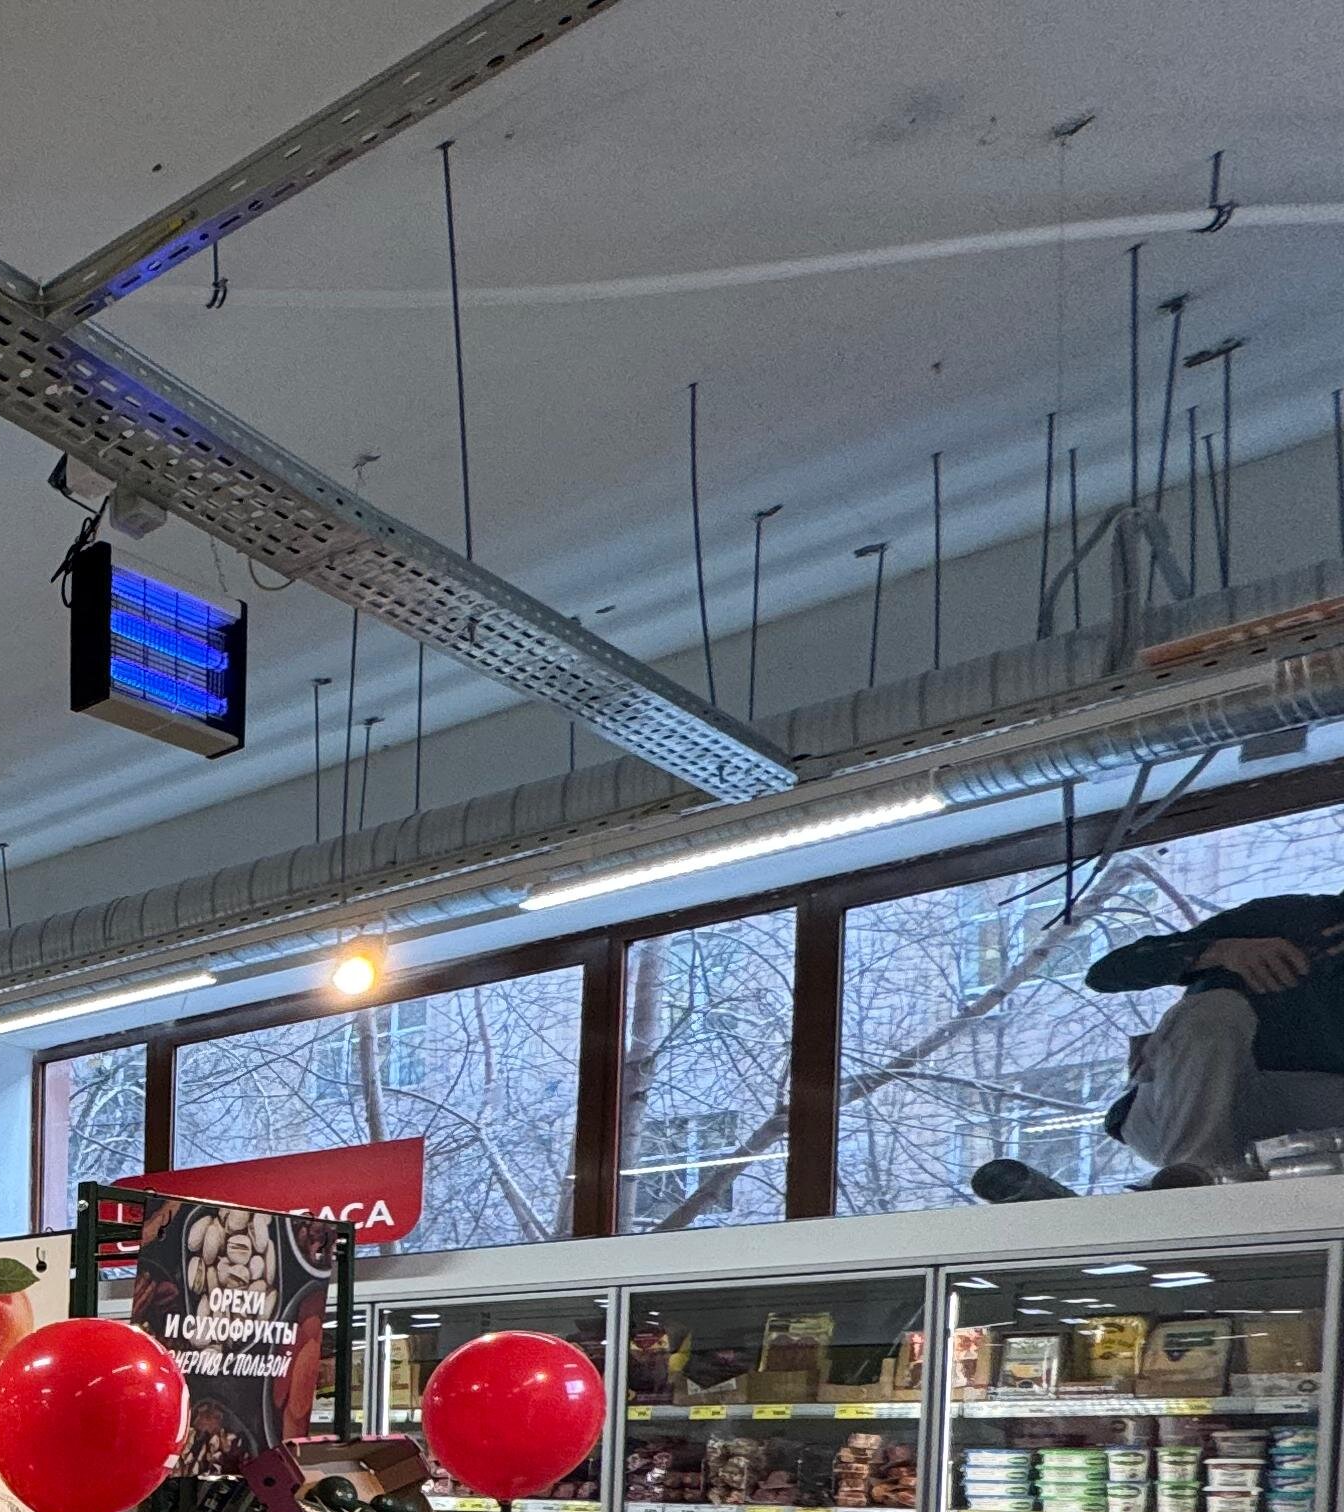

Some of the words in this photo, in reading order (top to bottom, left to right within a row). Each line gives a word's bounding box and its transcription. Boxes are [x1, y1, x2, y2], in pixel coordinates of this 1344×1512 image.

[210, 1287, 266, 1316] ОРЕХИ
[165, 1314, 179, 1338] И
[183, 1314, 298, 1345] СУХОФРУКТЫ
[223, 1353, 234, 1375] С
[233, 1351, 292, 1378] ПОЛЬЗОЙ
